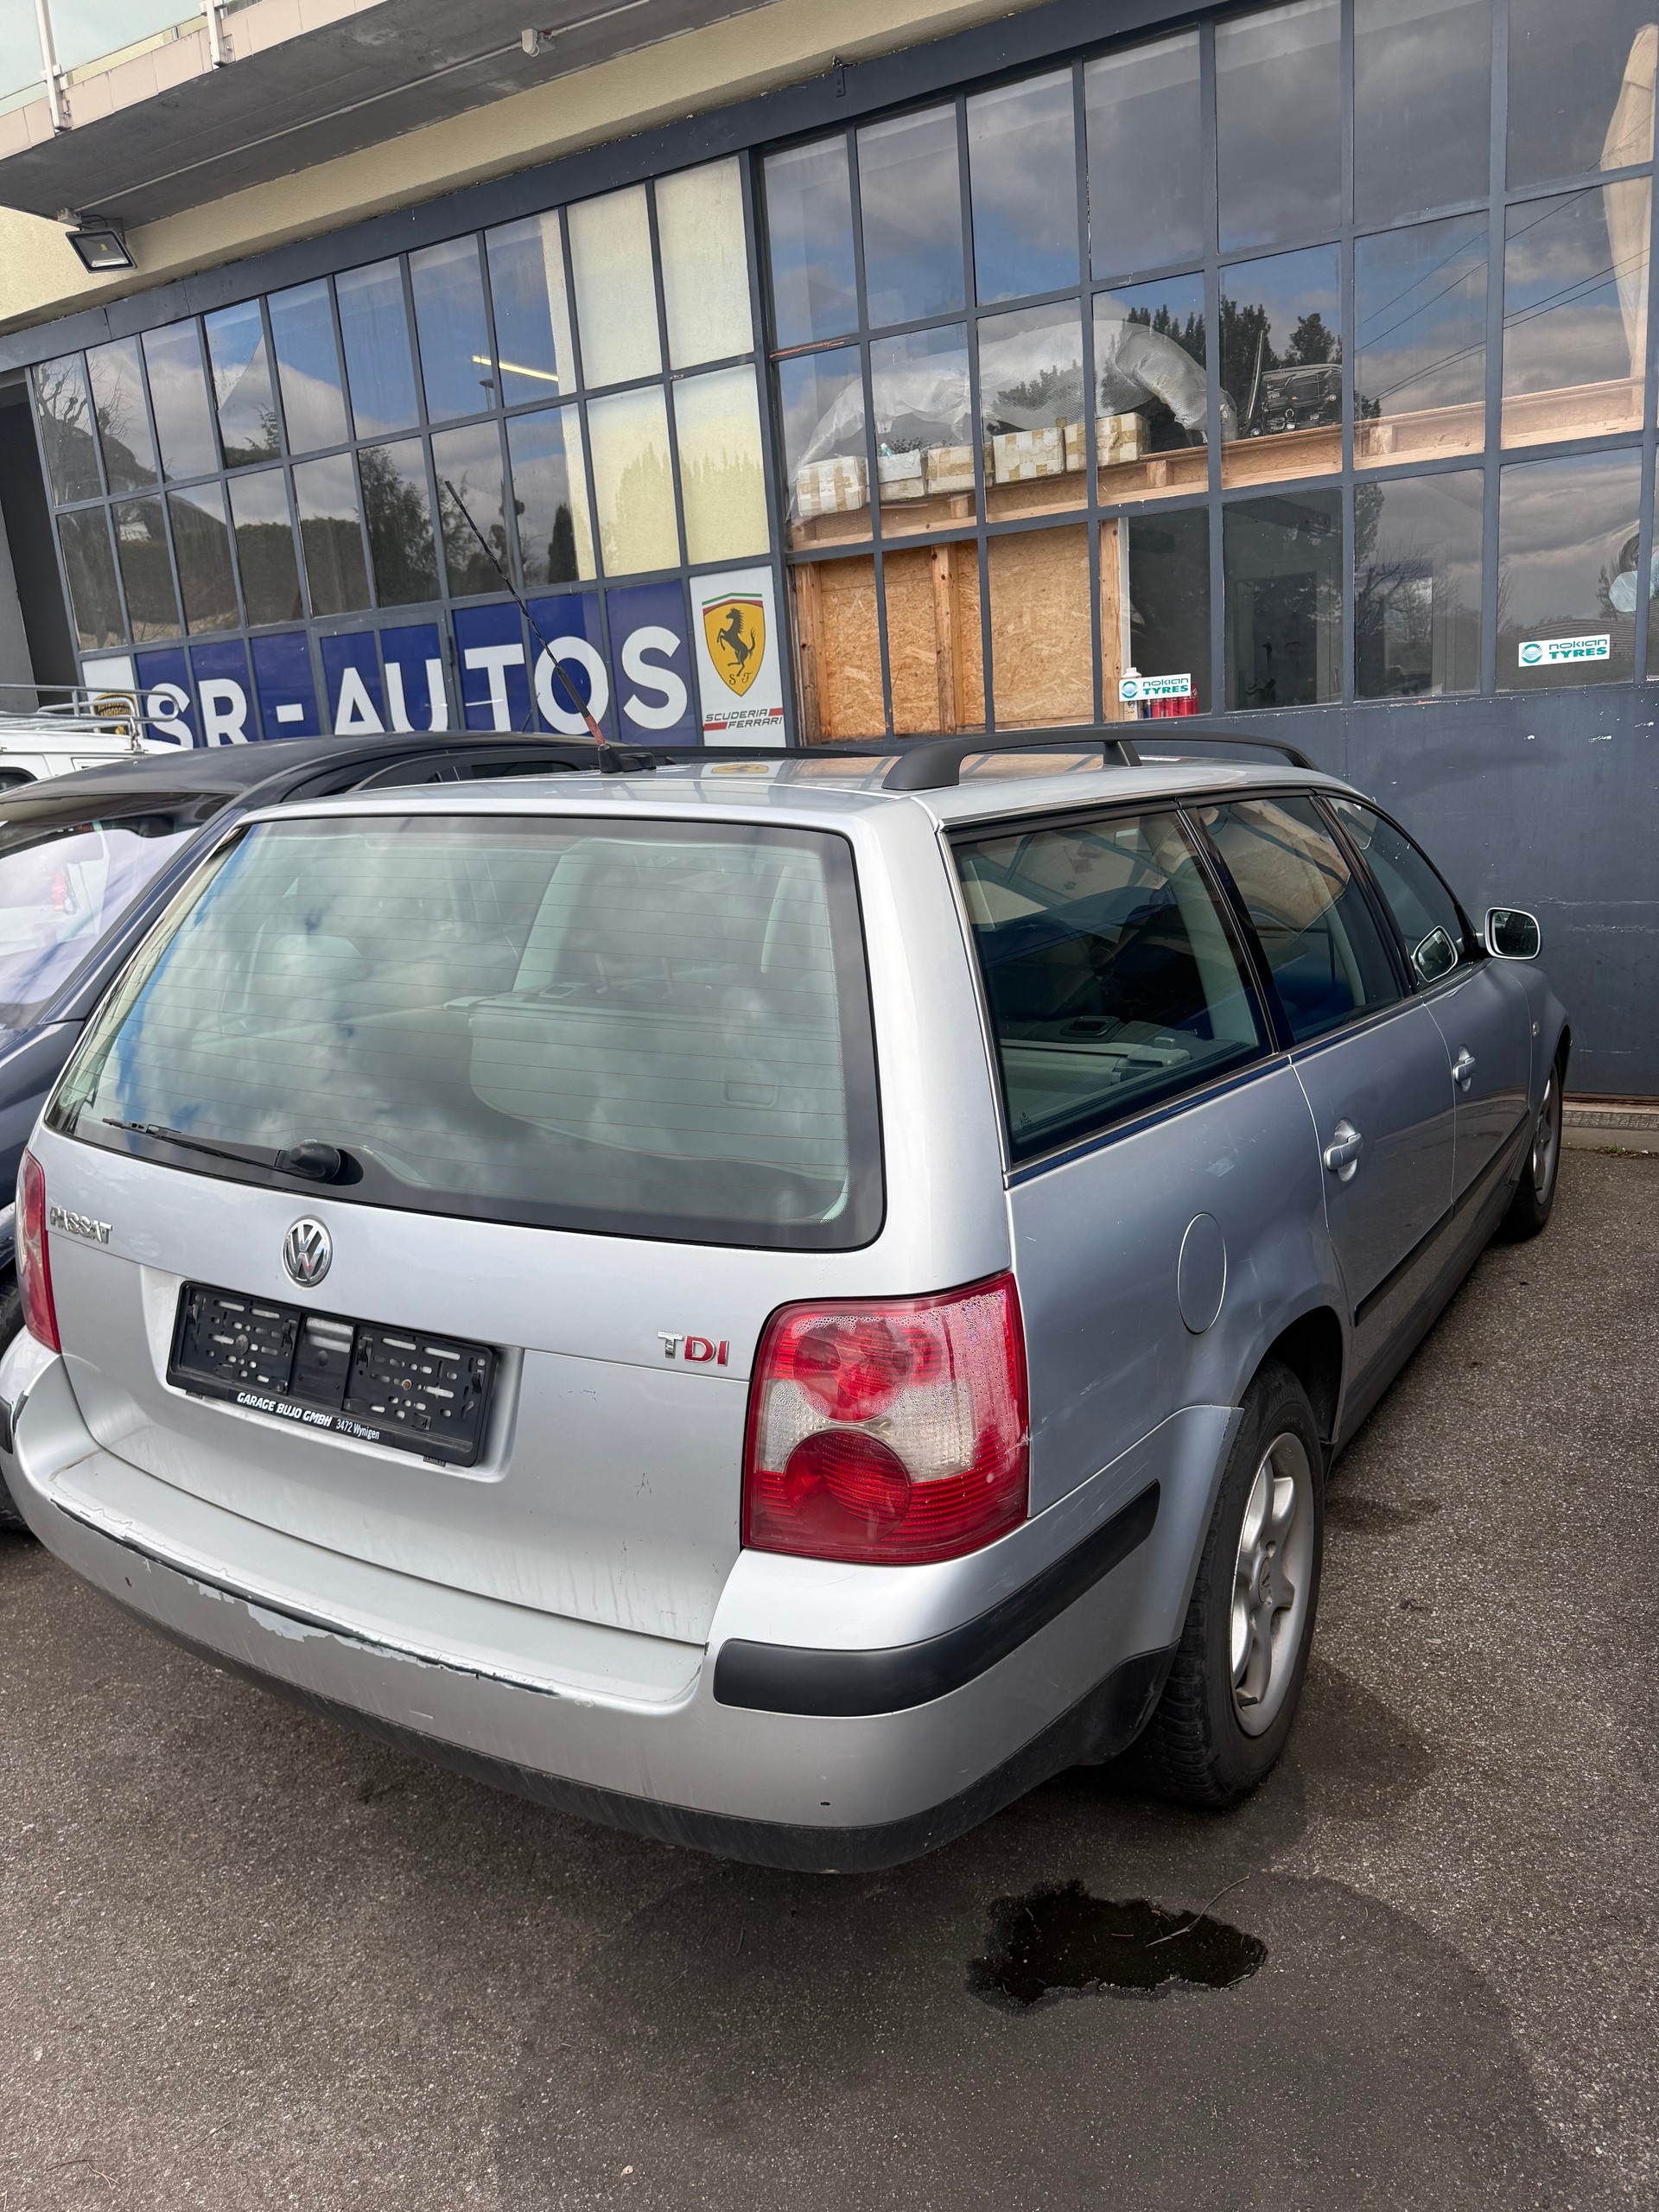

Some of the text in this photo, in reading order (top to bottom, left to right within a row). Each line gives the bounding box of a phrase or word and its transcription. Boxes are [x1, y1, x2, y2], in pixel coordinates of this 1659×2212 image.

[1549, 647, 1607, 659] TYRES
[1143, 685, 1188, 695] TYRES
[705, 709, 768, 722] SCUDERIA
[728, 716, 783, 729] FERRARI
[49, 1205, 113, 1244] PASSAT
[658, 1331, 729, 1367] TDI
[237, 1392, 380, 1440] GARAGE BUJO GMBH 3472 Wynigen
